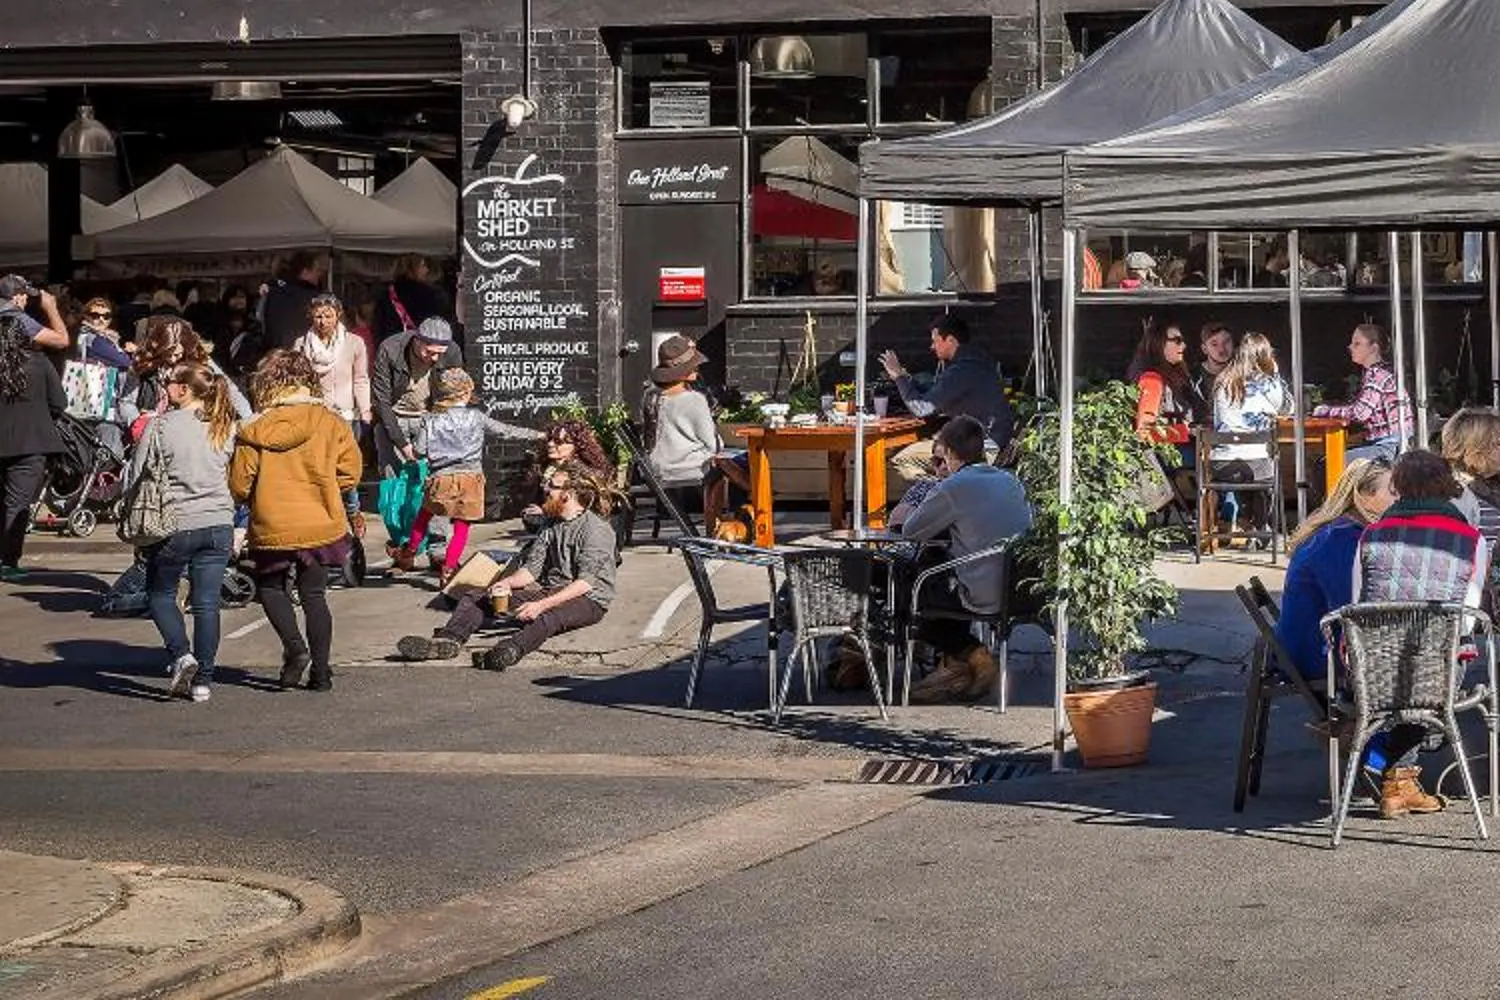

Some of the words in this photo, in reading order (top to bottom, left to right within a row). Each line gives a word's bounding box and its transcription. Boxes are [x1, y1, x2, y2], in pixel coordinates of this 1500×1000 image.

[651, 165, 699, 189] Holland
[493, 184, 511, 199] the
[477, 197, 557, 219] MARKET
[477, 217, 530, 237] SHED
[480, 241, 499, 253] on
[500, 238, 557, 251] HOLLAND
[485, 289, 541, 303] ORGANIC
[483, 317, 567, 331] SUSTAINABLE
[483, 343, 533, 356] ETHICAL
[535, 341, 589, 355] PRODUCE
[483, 361, 520, 376] OPEN
[522, 358, 566, 375] EVERY
[481, 374, 537, 391] SUNDAY
